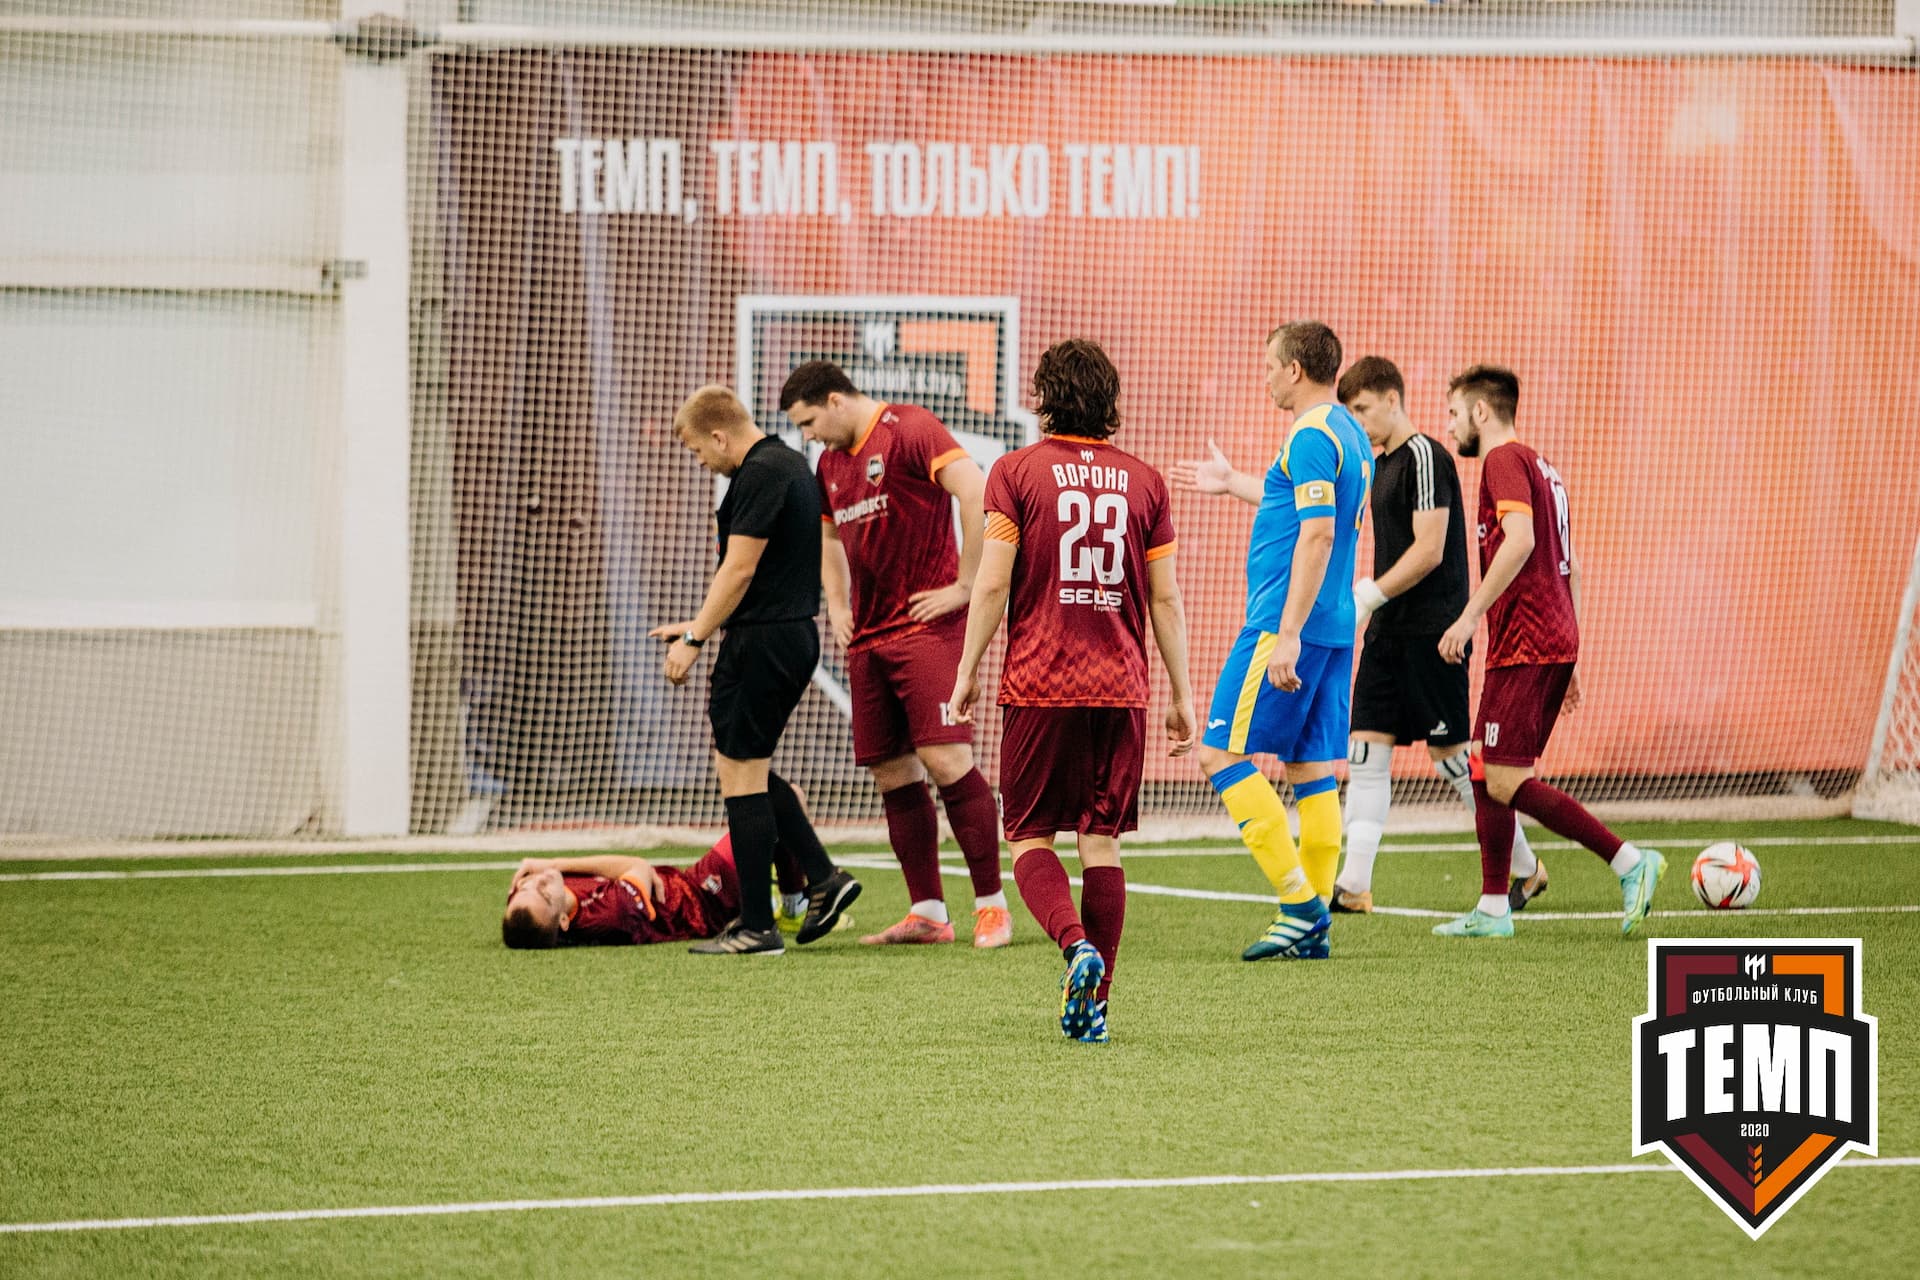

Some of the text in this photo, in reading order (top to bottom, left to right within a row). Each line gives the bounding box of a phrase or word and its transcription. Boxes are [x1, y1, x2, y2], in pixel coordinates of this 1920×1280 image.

[554, 138, 1200, 224] ТЕМП, ТЕМП, ТОЛЬКО ТЕМП!
[1051, 463, 1129, 493] ВОРОНА
[1057, 490, 1129, 585] 23
[1059, 588, 1123, 606] SEUS
[1485, 722, 1499, 747] 18
